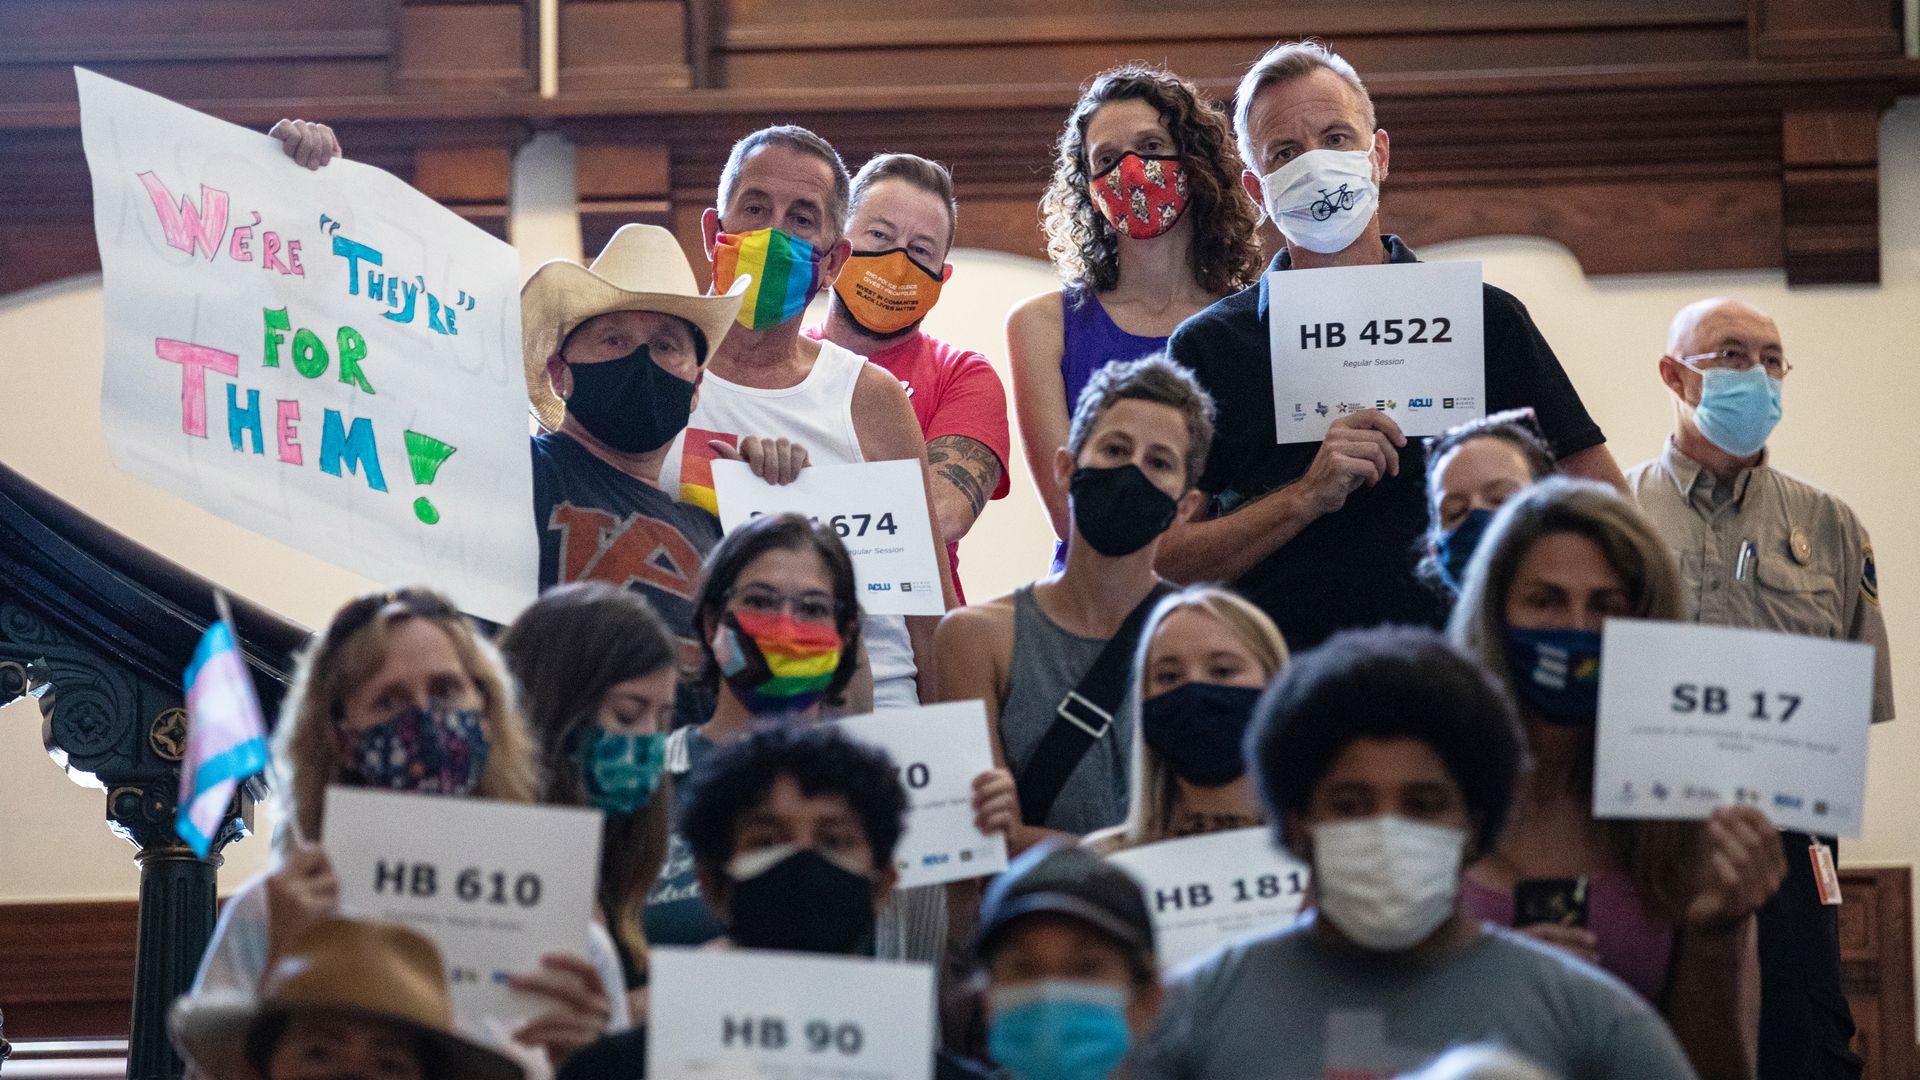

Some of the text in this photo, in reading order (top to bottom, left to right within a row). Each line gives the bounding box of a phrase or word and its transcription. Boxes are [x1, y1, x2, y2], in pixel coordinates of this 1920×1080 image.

[137, 170, 305, 278] WE'RE
[262, 306, 376, 395] FOR
[1300, 317, 1452, 350] HB 4522
[1343, 358, 1405, 369] Regular Session
[1408, 398, 1433, 408] ACLU
[811, 511, 898, 538] 674
[1671, 683, 1802, 723] SB 17
[374, 859, 542, 908] HB 610
[1155, 883, 1214, 912] HB
[722, 1014, 865, 1056] HB 90
